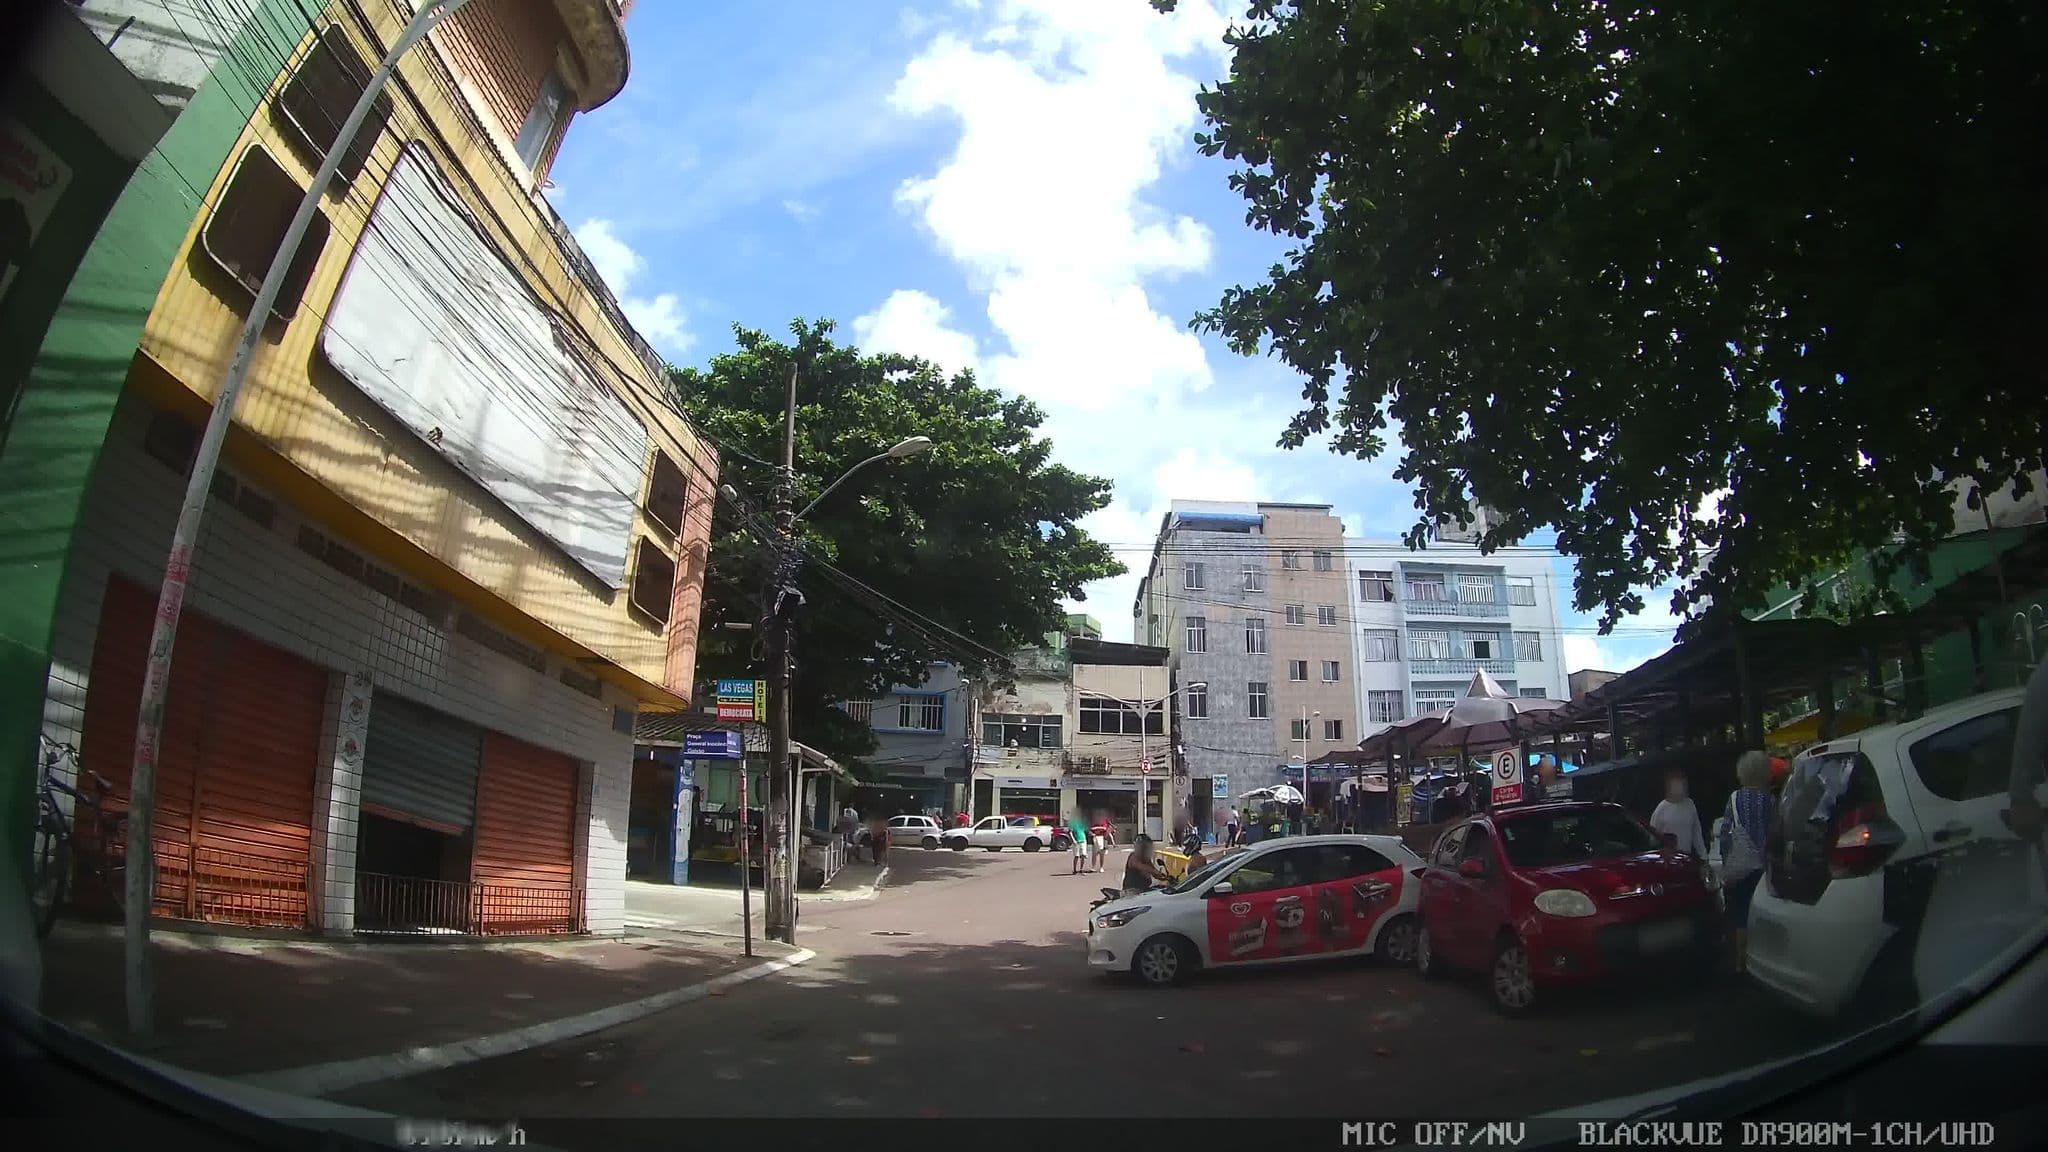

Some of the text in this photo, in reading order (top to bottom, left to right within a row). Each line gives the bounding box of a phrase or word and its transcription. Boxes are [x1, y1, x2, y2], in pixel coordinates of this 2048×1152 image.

[720, 682, 753, 693] LAS VEGAS
[1503, 758, 1510, 774] E
